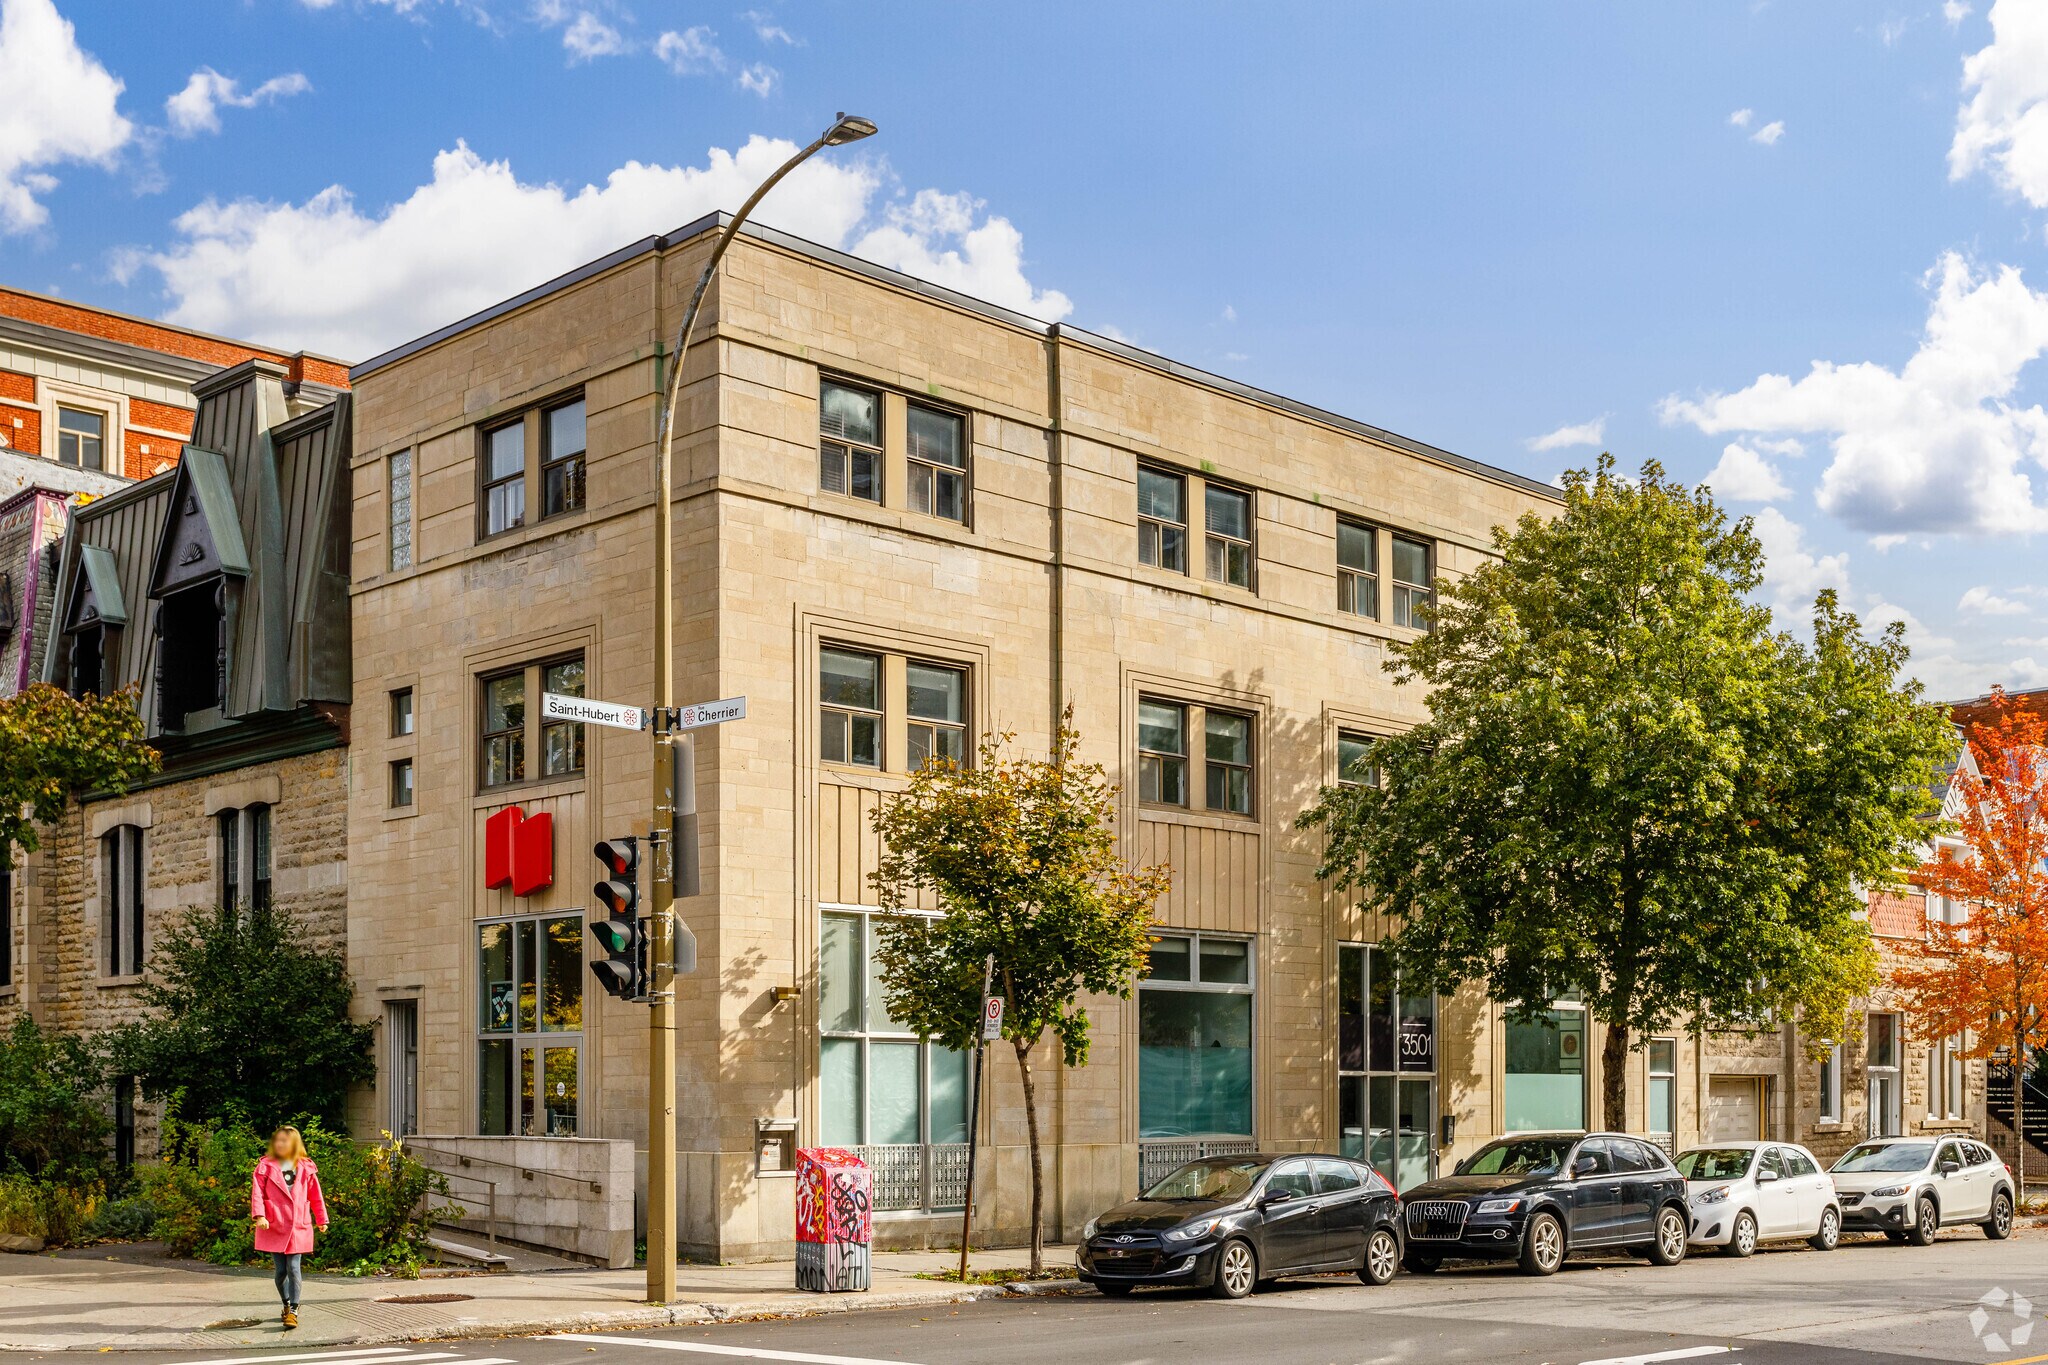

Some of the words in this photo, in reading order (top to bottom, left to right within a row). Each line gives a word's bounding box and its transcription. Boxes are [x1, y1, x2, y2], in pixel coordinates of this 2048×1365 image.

[549, 701, 620, 722] Saint-Hubert
[698, 706, 739, 721] Cherrier
[1402, 1033, 1432, 1056] 3501
